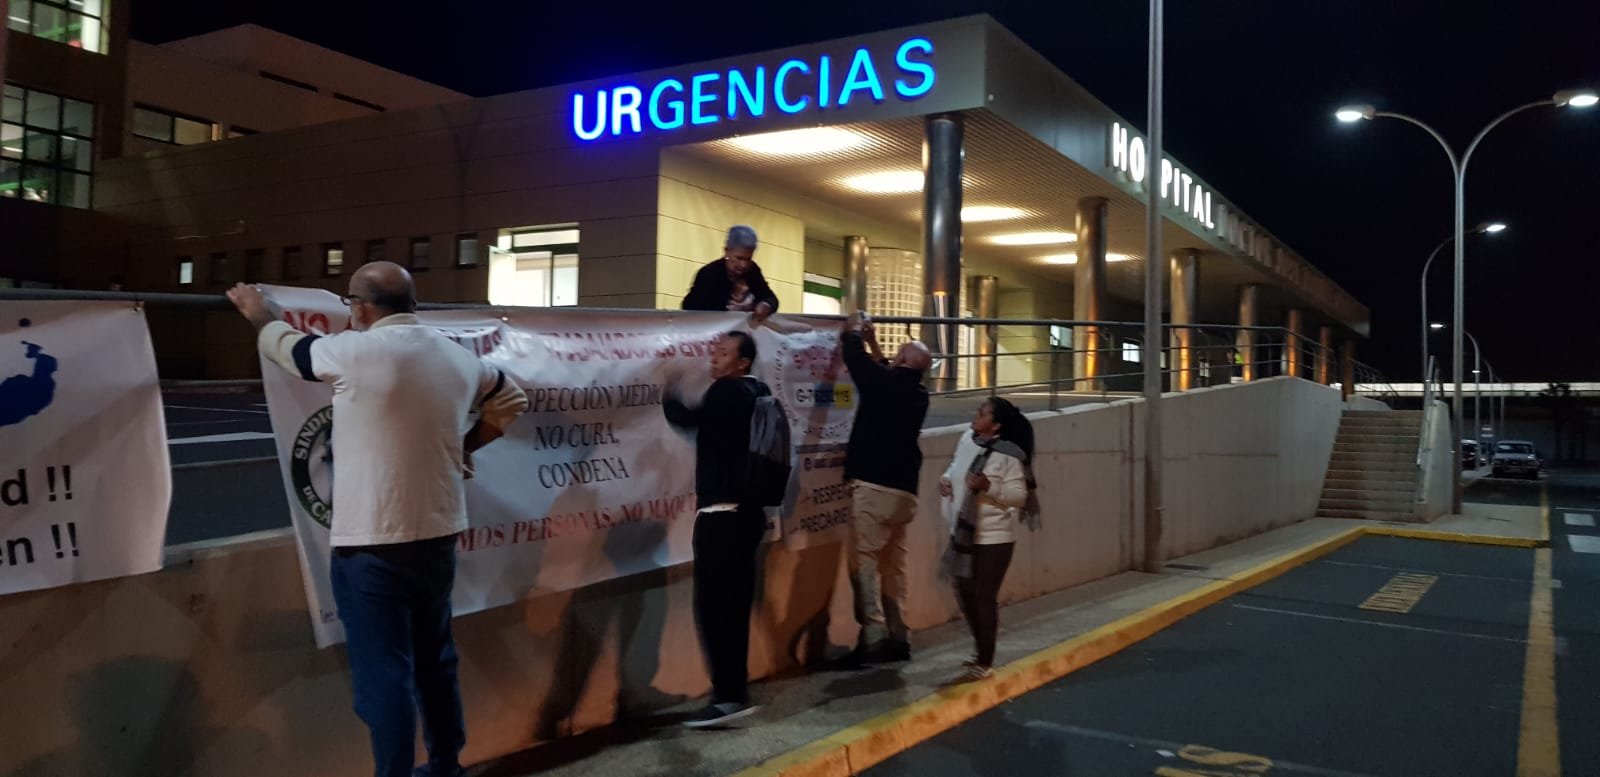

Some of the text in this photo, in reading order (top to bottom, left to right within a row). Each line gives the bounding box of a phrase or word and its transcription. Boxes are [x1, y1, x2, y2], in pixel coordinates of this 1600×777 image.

[573, 38, 935, 141] URGENCIAS
[1112, 121, 1215, 229] HOPITAL
[522, 379, 614, 413] SPECCIÓN
[533, 422, 620, 451] NO CURA,
[538, 457, 630, 489] CONDENA
[457, 523, 505, 551] MOS
[512, 507, 616, 544] PERSONAS,
